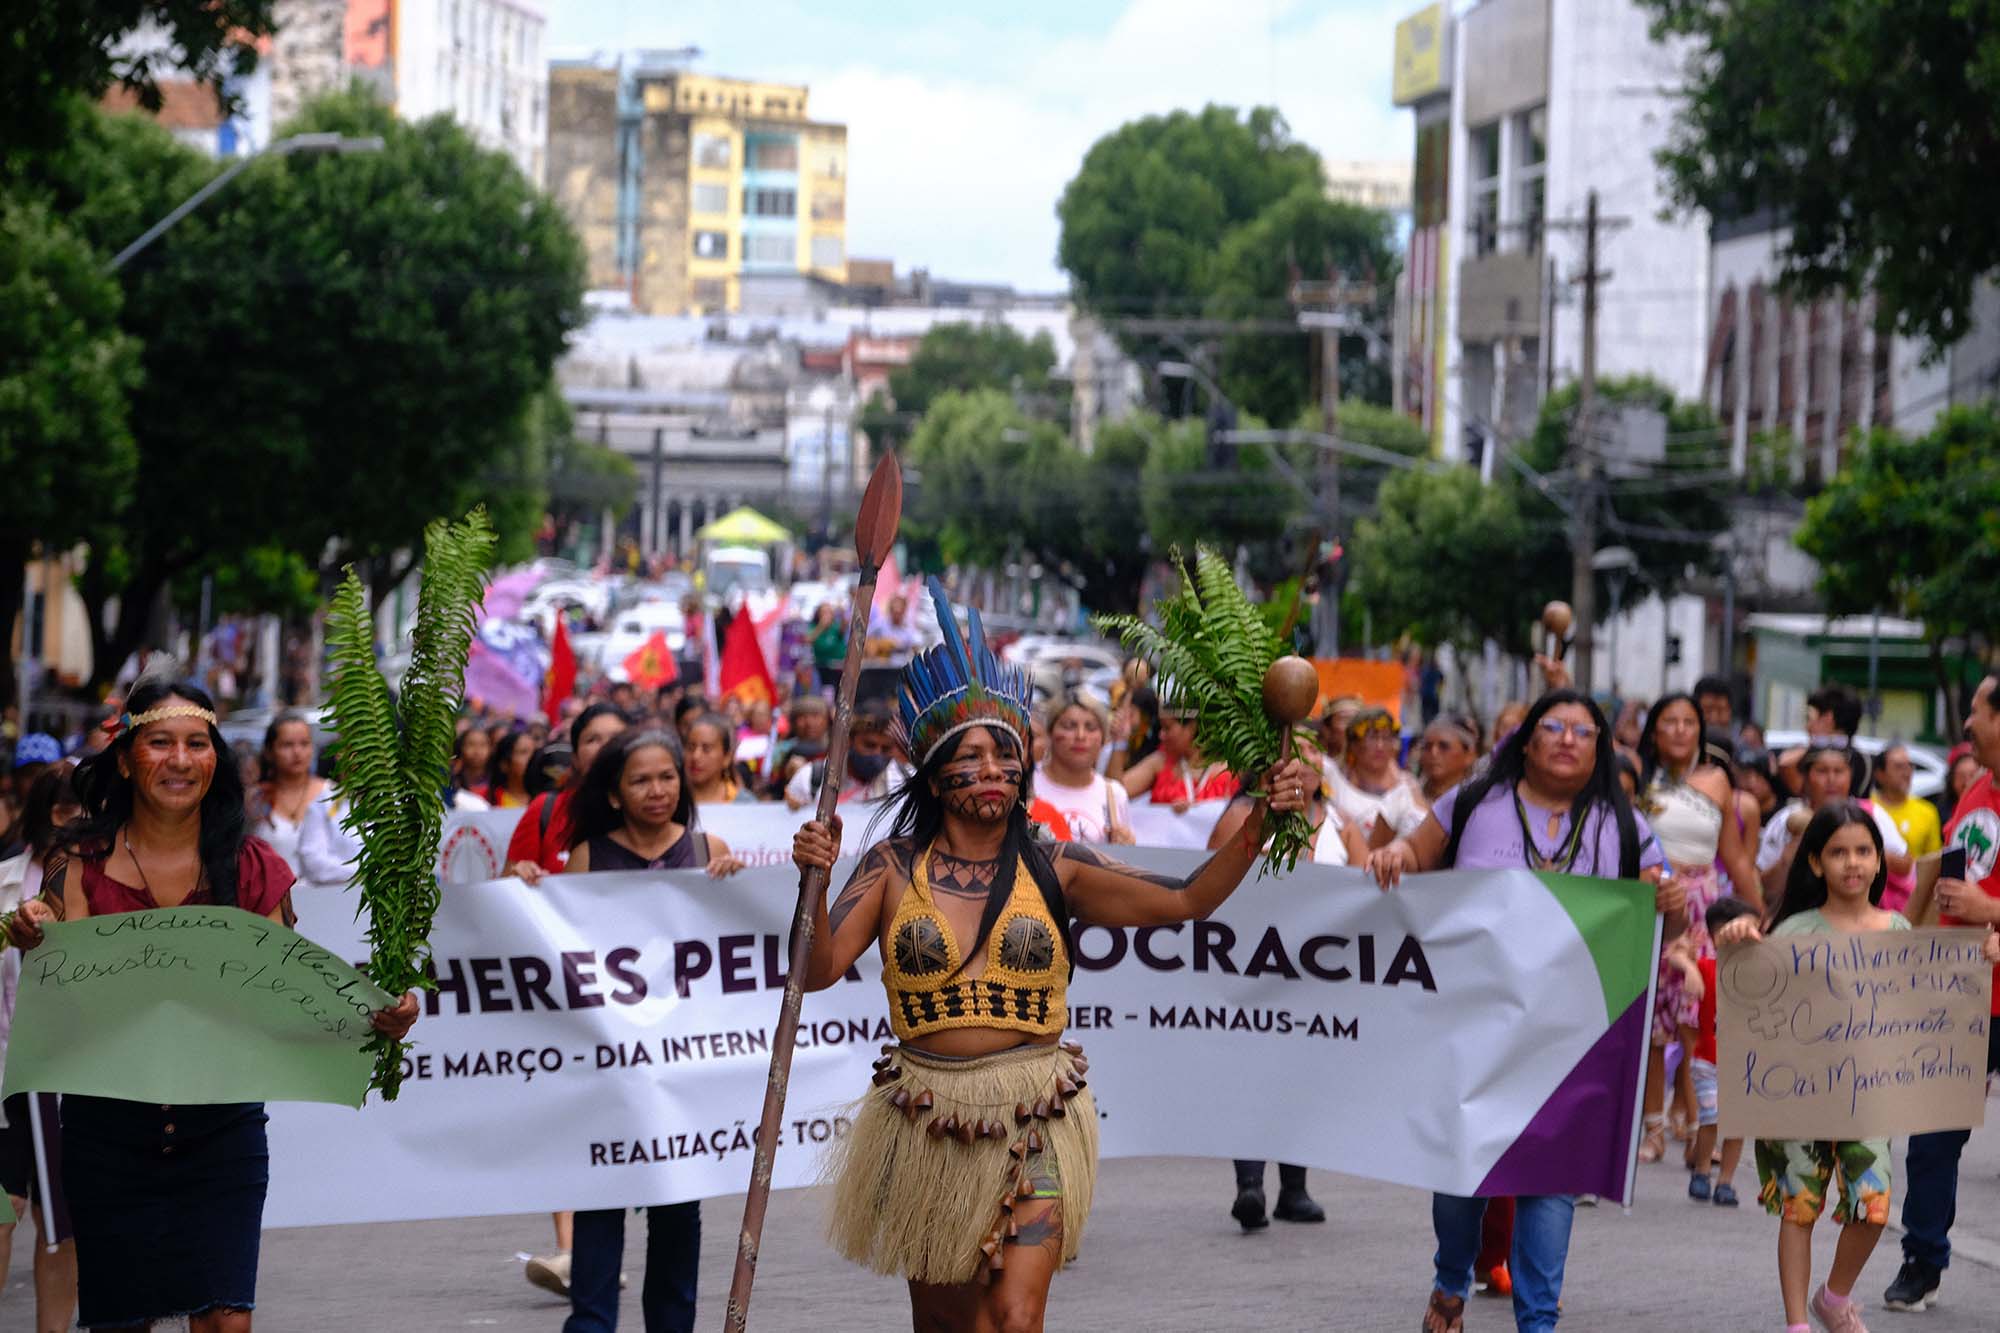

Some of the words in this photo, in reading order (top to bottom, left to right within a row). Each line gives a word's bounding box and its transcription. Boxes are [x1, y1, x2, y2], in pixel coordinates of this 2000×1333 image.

[96, 913, 236, 937] Aldeia
[34, 943, 196, 986] Resistir
[354, 946, 648, 1017] HERES
[1071, 920, 1437, 992] OCRACIA
[444, 1047, 563, 1082] MARÇO
[595, 1039, 651, 1070] DIA
[662, 1016, 895, 1063] INTERNCIONA
[1150, 1005, 1359, 1041] MANAUS-AM
[792, 1115, 853, 1145] TOD
